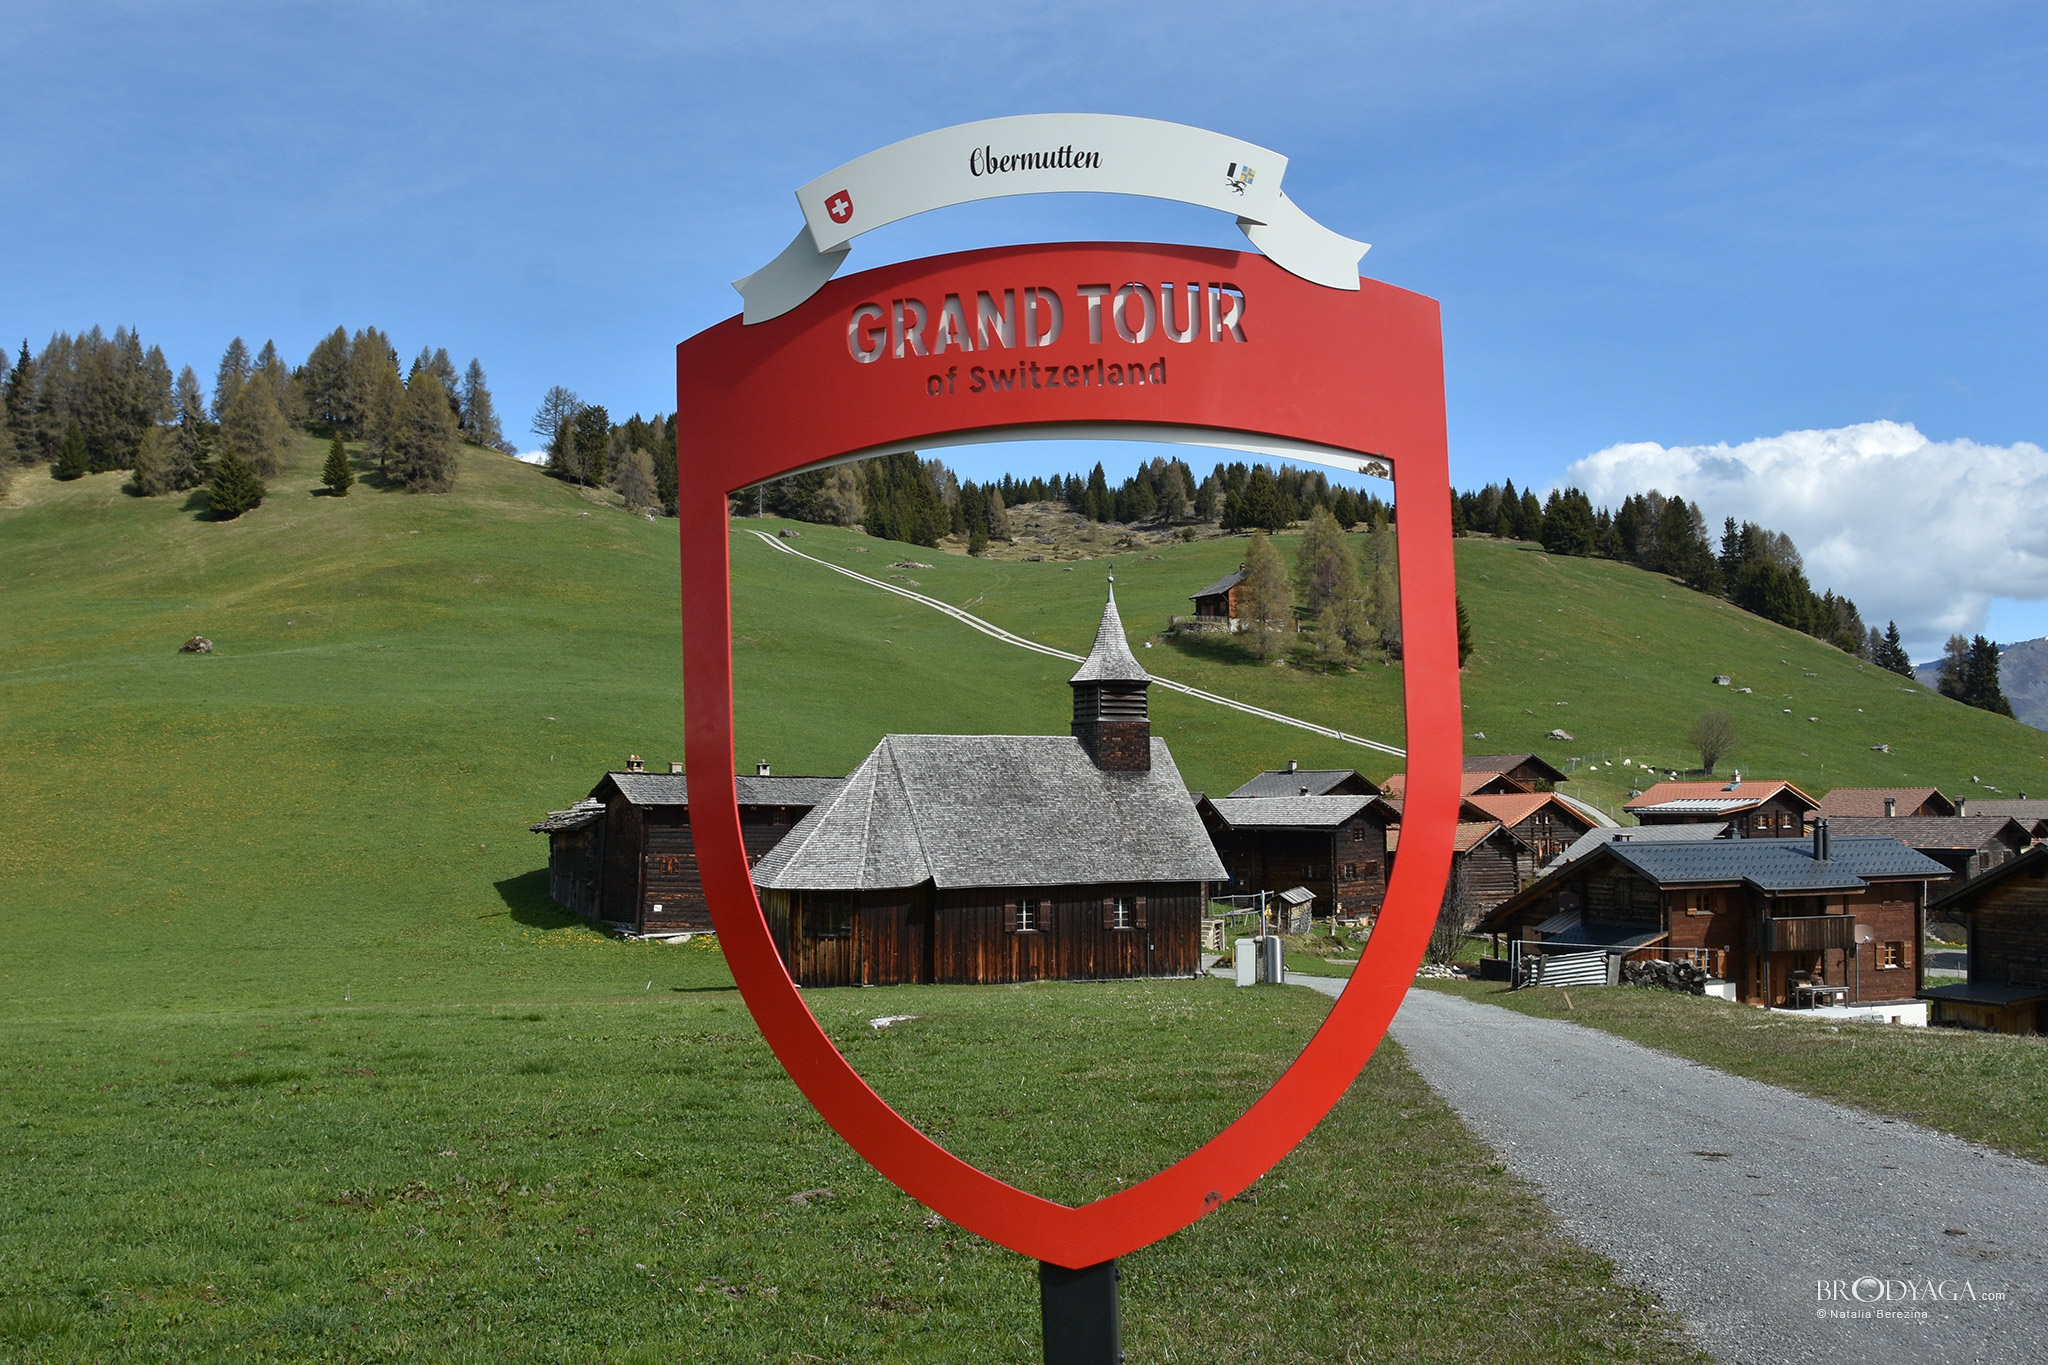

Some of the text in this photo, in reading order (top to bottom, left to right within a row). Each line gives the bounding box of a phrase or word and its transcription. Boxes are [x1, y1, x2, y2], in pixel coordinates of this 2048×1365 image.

[969, 145, 1103, 178] Obermutten
[847, 281, 1249, 364] GRAND TOUR
[927, 357, 1167, 397] of Switzerland
